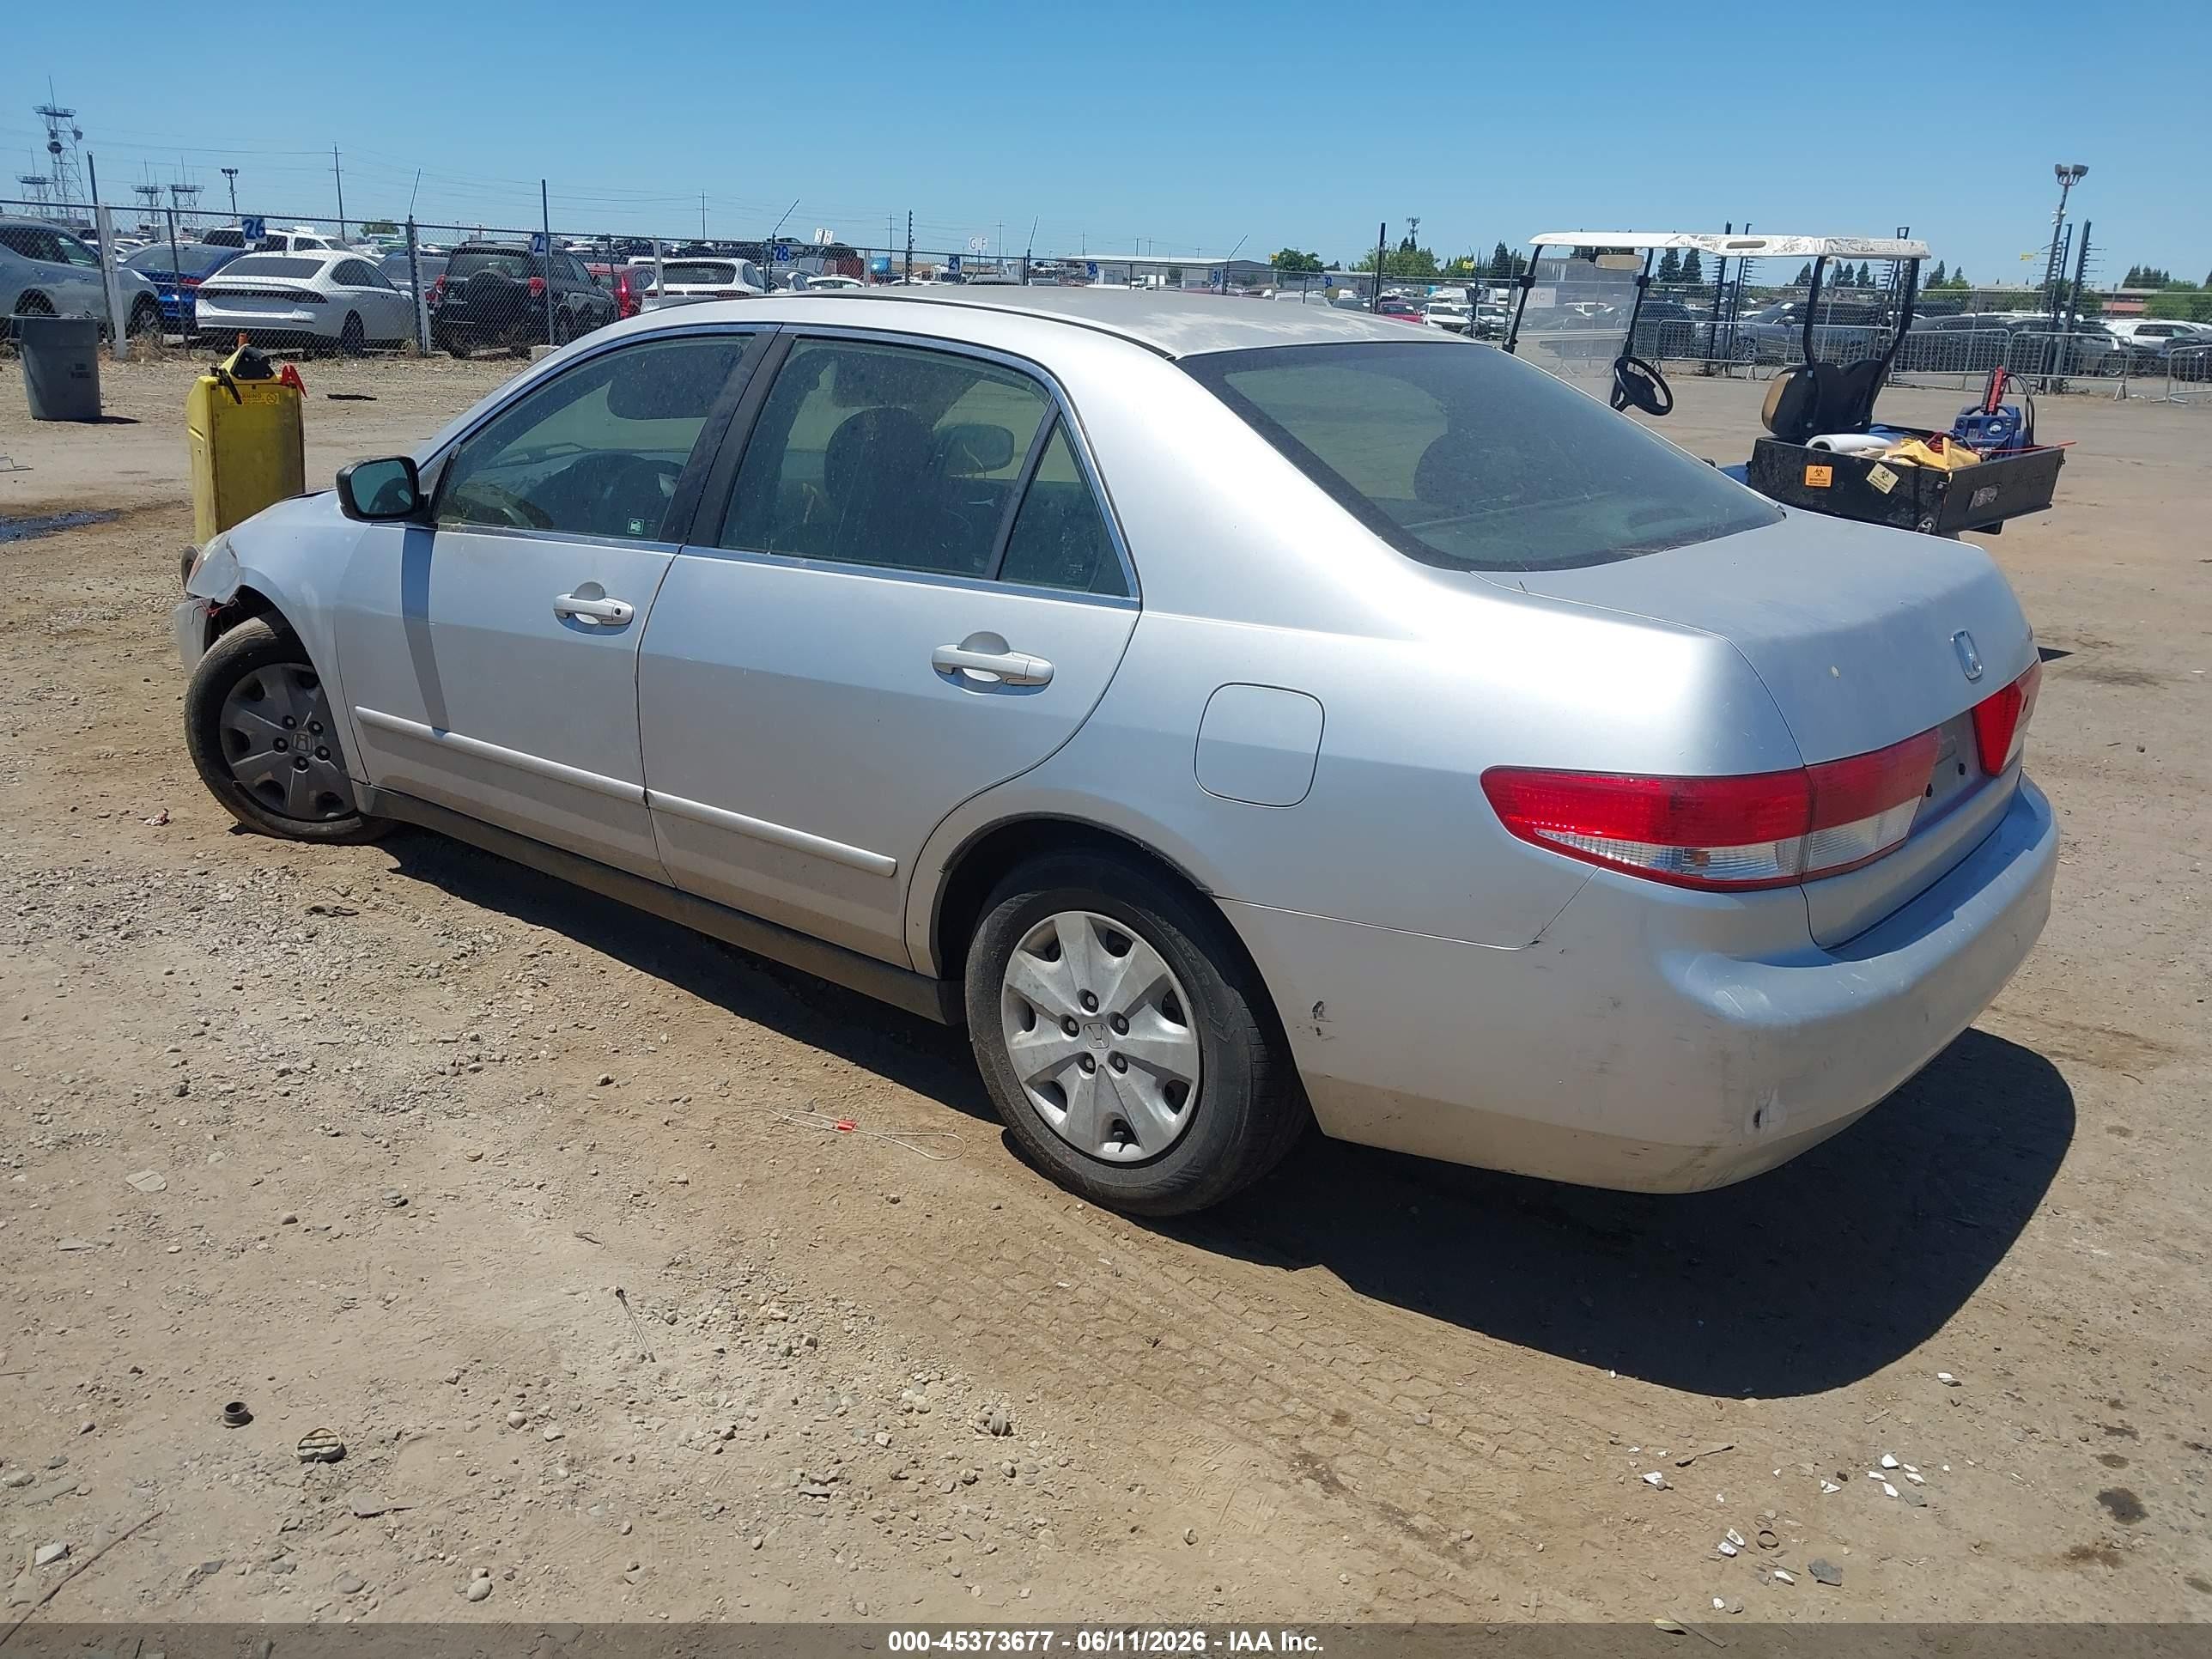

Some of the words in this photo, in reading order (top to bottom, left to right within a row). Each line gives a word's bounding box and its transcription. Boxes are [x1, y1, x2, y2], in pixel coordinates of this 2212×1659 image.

[242, 218, 266, 240] 26
[969, 237, 976, 250] G
[774, 246, 789, 262] 28
[949, 257, 960, 272] 29
